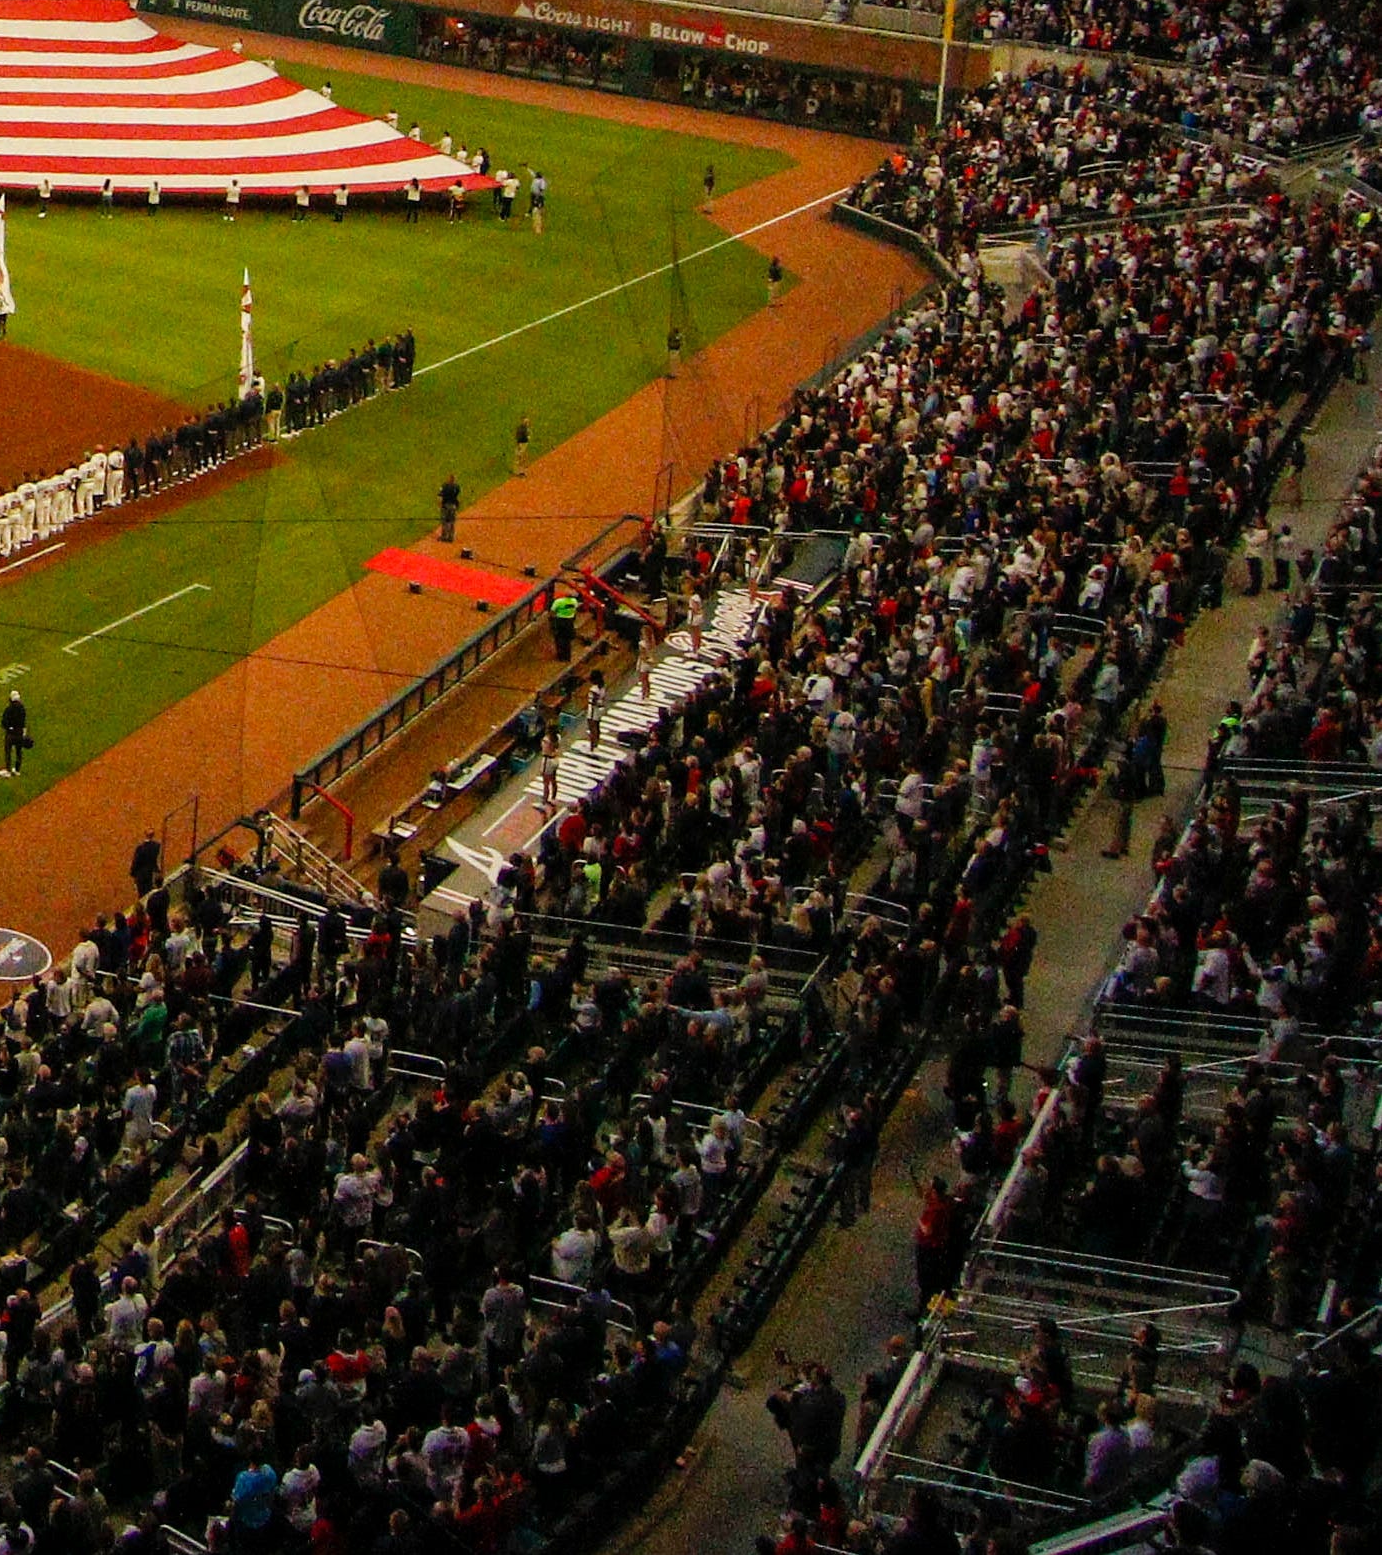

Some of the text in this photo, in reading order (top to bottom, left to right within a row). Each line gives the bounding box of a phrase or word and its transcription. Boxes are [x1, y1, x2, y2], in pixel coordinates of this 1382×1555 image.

[585, 15, 632, 33] LIGHT
[650, 22, 705, 45] BELOW
[725, 34, 770, 56] CHOP
